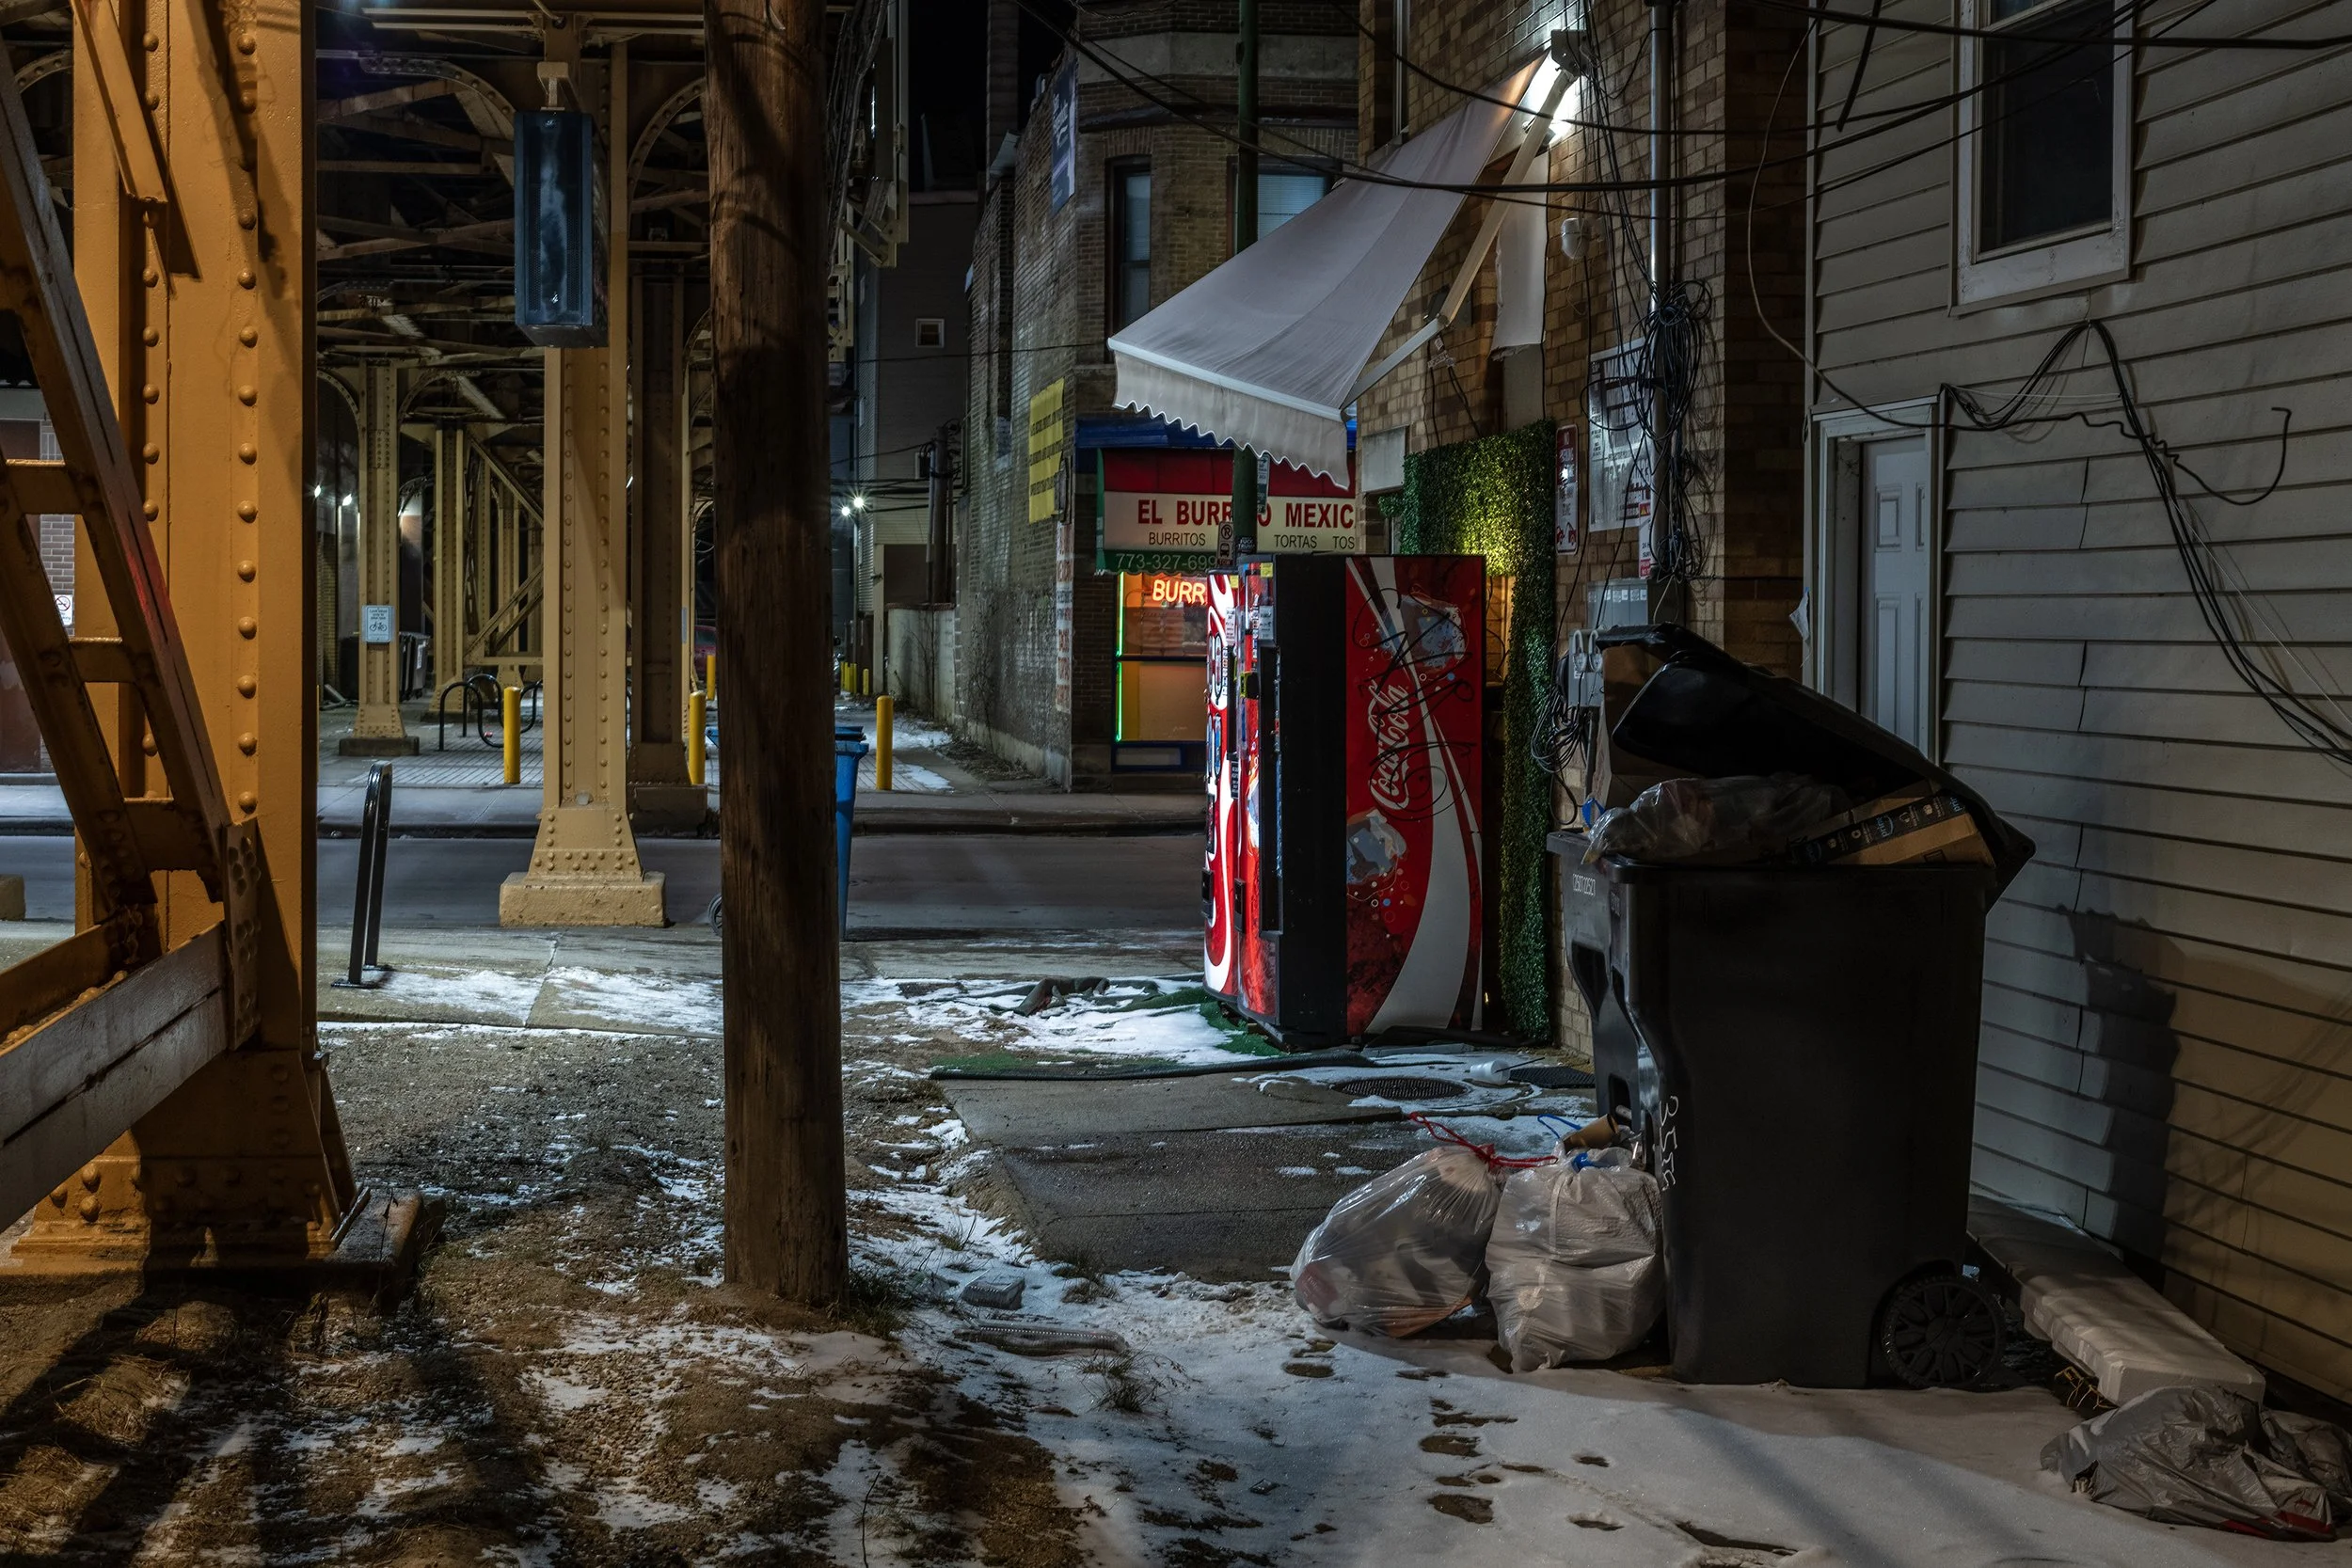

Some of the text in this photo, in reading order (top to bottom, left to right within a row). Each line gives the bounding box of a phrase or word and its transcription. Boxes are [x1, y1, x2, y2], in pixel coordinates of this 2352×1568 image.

[1137, 499, 1163, 525] EL
[1177, 499, 1272, 527] BURRO
[1285, 502, 1355, 529] MEXIC
[1149, 531, 1206, 546] BURRITOS
[1275, 534, 1317, 549] TORTAS
[1152, 579, 1206, 605] BURR
